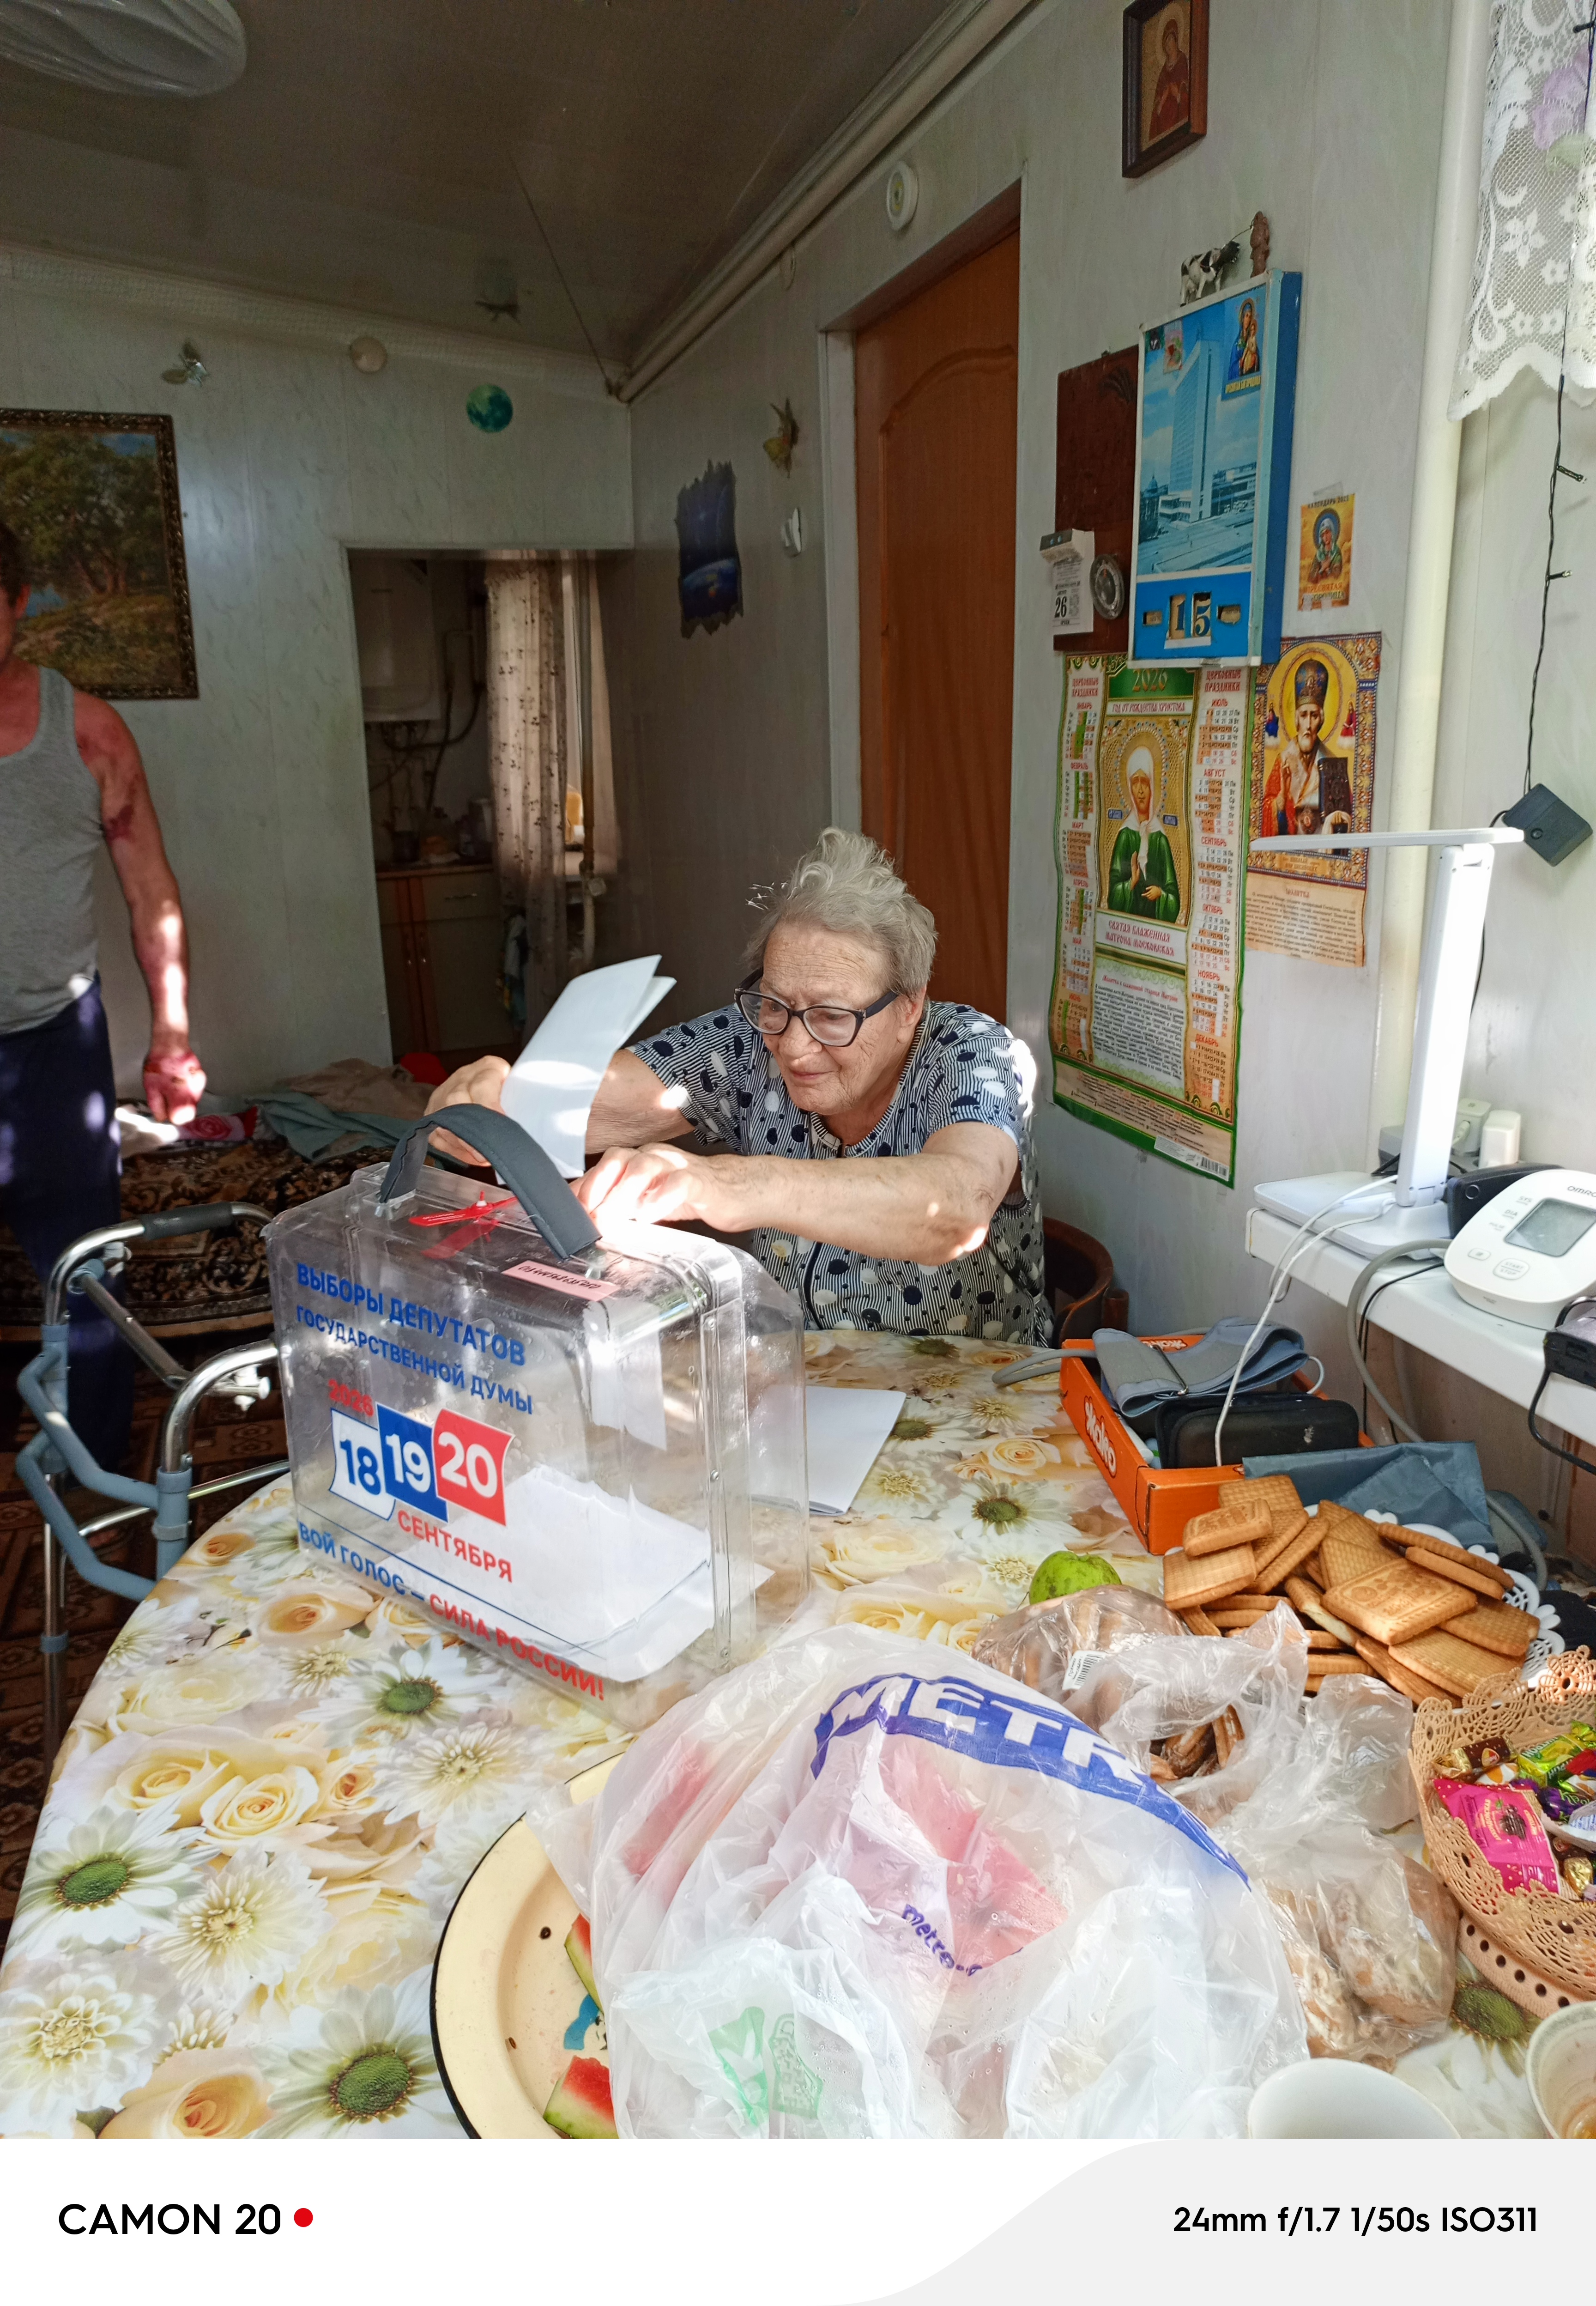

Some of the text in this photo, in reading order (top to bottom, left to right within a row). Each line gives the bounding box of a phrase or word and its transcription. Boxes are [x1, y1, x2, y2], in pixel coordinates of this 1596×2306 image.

[1054, 596, 1067, 618] 26
[1132, 668, 1168, 692] 2026
[1207, 669, 1241, 680] ЦЕРКОВНЫЕ
[1205, 682, 1240, 692] ПРАЗДНИКИ
[1211, 698, 1228, 707] ИЮЛЬ
[1204, 769, 1226, 777] АВГУСТ
[1201, 837, 1227, 847] СЕНТЯБРЬ
[1203, 904, 1222, 914] ОКТЯБРЬ
[1109, 920, 1170, 942] СВЯТАЯ БЛАЖЕННАЯ
[1106, 932, 1174, 956] МАТРОНА МОСКОВСКАЯ
[1198, 970, 1220, 981] НОЯБРЬ
[1196, 1033, 1218, 1047] ДЕКАБРЬ
[297, 1262, 526, 1366] ВЫБОРЫ ДЕПУТАТОВ
[296, 1305, 532, 1414] ГОСУДАРСТВЕННОЙ ДУМЫ
[328, 1379, 374, 1417] 2026
[339, 1431, 498, 1498] 18 19 20
[398, 1510, 513, 1583] СЕНТЯБРЯ
[297, 1519, 336, 1559] ВОЙ
[340, 1545, 405, 1596] ГОЛОС
[429, 1593, 490, 1642] СИЛА
[496, 1627, 605, 1701] РОССИИ!
